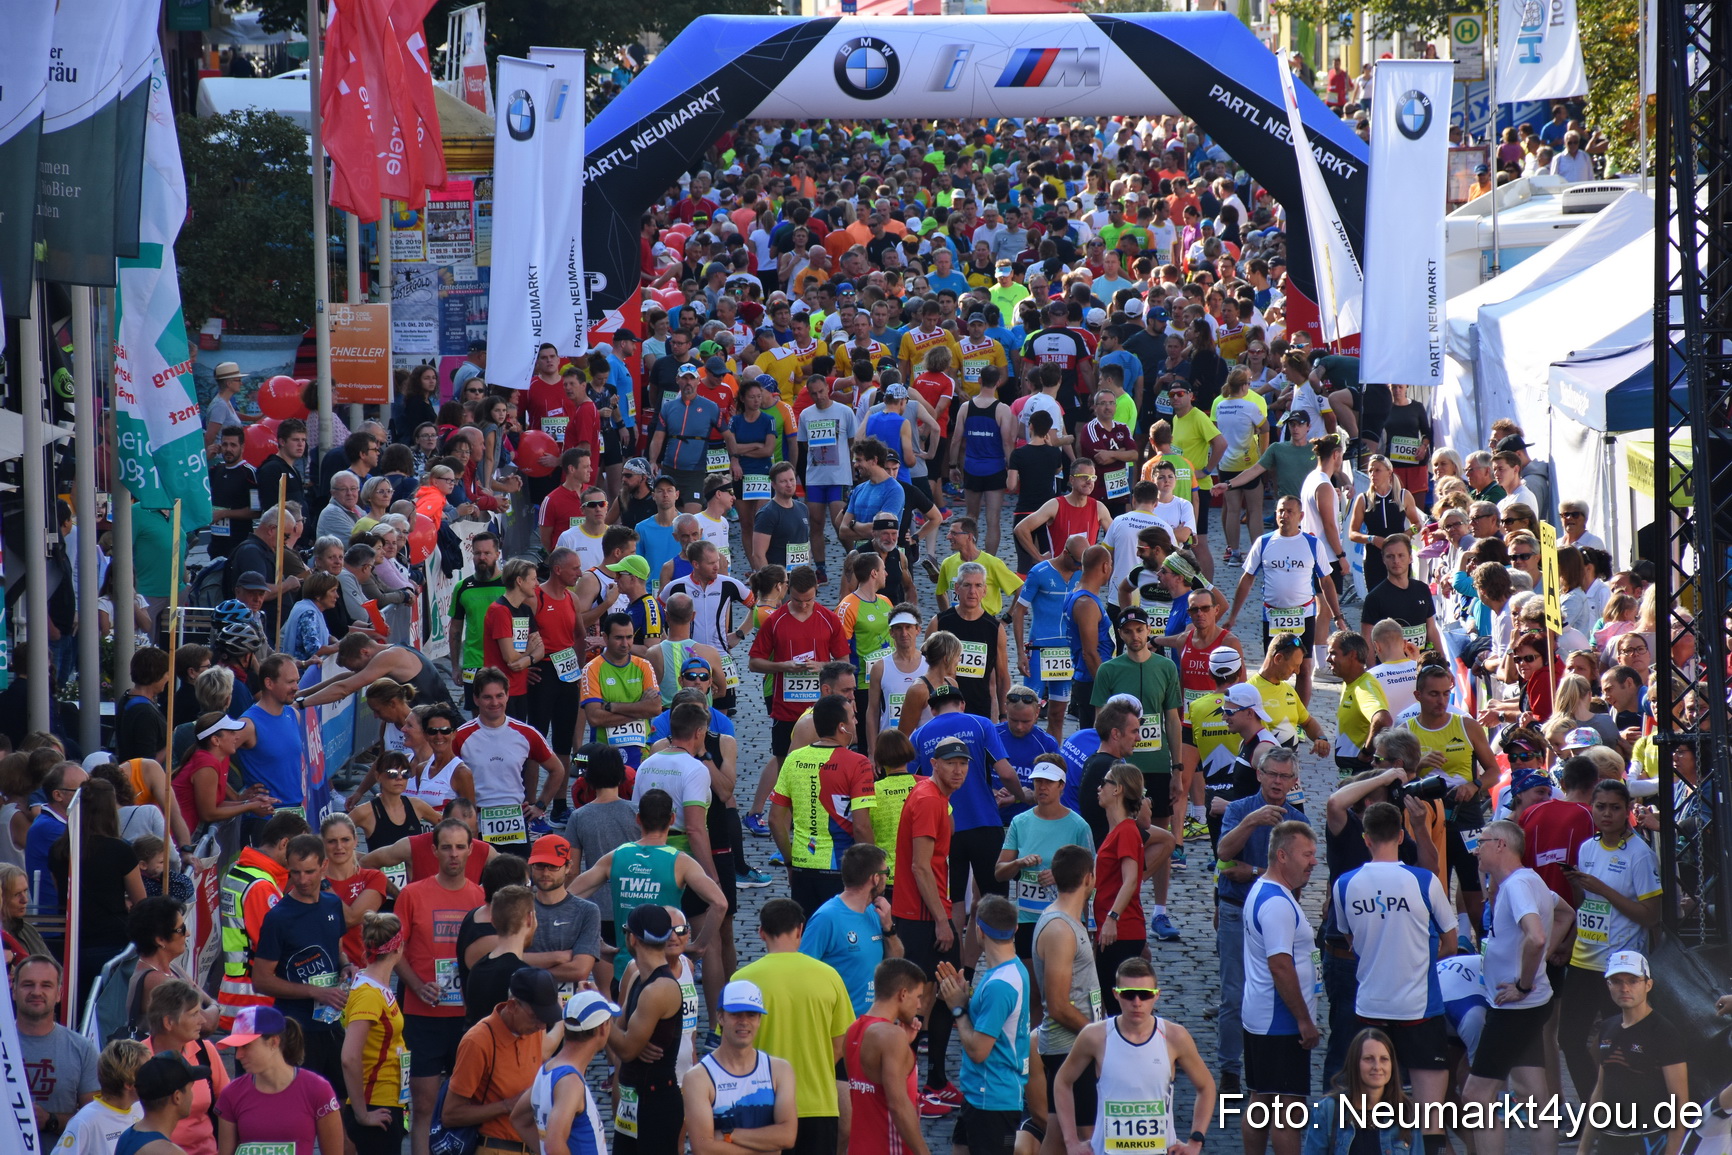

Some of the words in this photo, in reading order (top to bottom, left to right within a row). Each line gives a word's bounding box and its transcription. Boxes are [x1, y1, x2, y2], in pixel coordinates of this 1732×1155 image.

[840, 37, 894, 57] BMW
[1207, 83, 1261, 127] PARTL
[582, 148, 634, 187] PARTL
[630, 85, 722, 154] NEUMARKT
[568, 236, 583, 306] NEUMARKT
[528, 261, 543, 337] NEUMARKT
[1427, 257, 1438, 334] NEUMARKT
[573, 308, 583, 348] PARTL
[915, 343, 932, 351] MAX
[932, 337, 947, 347] BÖGL
[1430, 334, 1440, 378] PARTL
[545, 425, 567, 434] 2568
[811, 429, 832, 438] 2771
[1395, 445, 1417, 455] 1068
[707, 456, 726, 464] 1297
[746, 483, 768, 491] 2772
[1547, 557, 1557, 610] A
[647, 598, 658, 627] BOCK
[1274, 617, 1301, 627] 1293
[1042, 649, 1070, 657] BOCK
[1045, 659, 1071, 670] 1216
[1189, 659, 1206, 670] DJK
[788, 679, 819, 690] 2573
[611, 722, 643, 735] 2510
[795, 760, 816, 769] Team
[818, 762, 838, 771] Partl
[651, 768, 682, 777] Königstein
[884, 787, 906, 796] Team
[810, 774, 818, 836] Motorsport
[484, 807, 520, 818] BOCK
[487, 819, 520, 833] 1079
[489, 834, 519, 843] MICHAEL
[619, 876, 661, 893] TWin
[620, 891, 659, 900] NEUMARKT
[1352, 893, 1411, 917] SUSPA
[1578, 912, 1604, 930] 1367
[296, 958, 326, 978] RUN
[717, 1082, 738, 1090] ATSV
[1110, 1104, 1160, 1115] BOCK
[1112, 1119, 1159, 1136] 1163
[239, 1144, 289, 1155] BOCK
[1115, 1141, 1156, 1149] MARKUS
